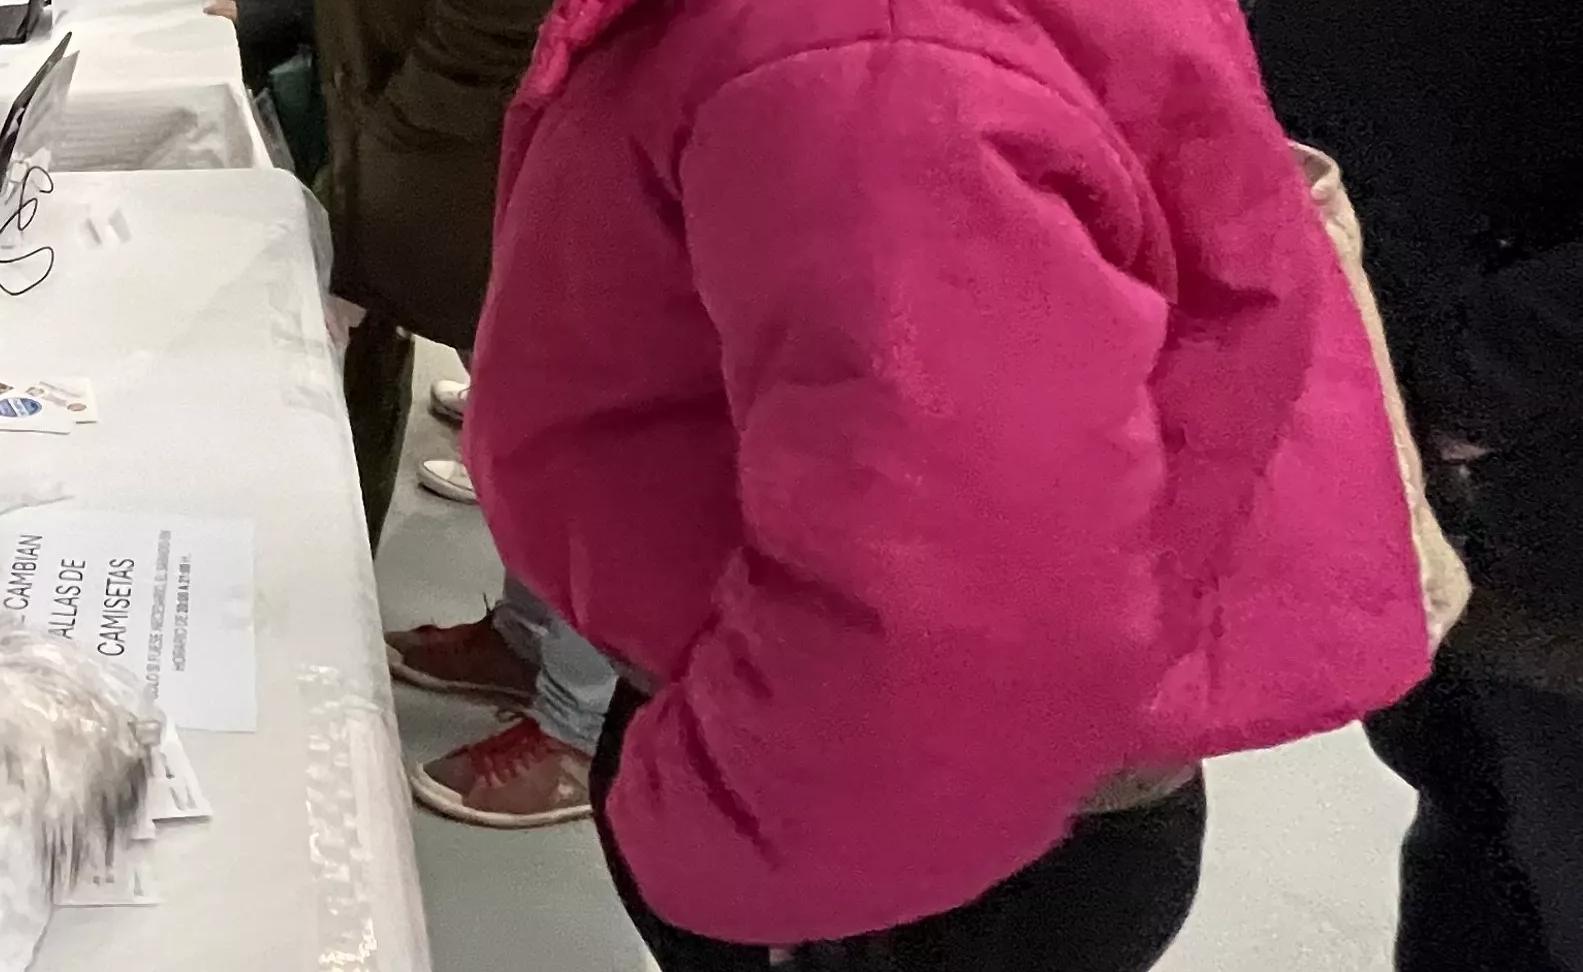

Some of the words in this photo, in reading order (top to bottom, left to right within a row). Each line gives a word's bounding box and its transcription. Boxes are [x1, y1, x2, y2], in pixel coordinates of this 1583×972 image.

[3, 534, 43, 610] CAMBIAN
[58, 558, 86, 581] DE
[48, 584, 81, 640] ALLAS
[97, 558, 135, 657] CAMISETAS
